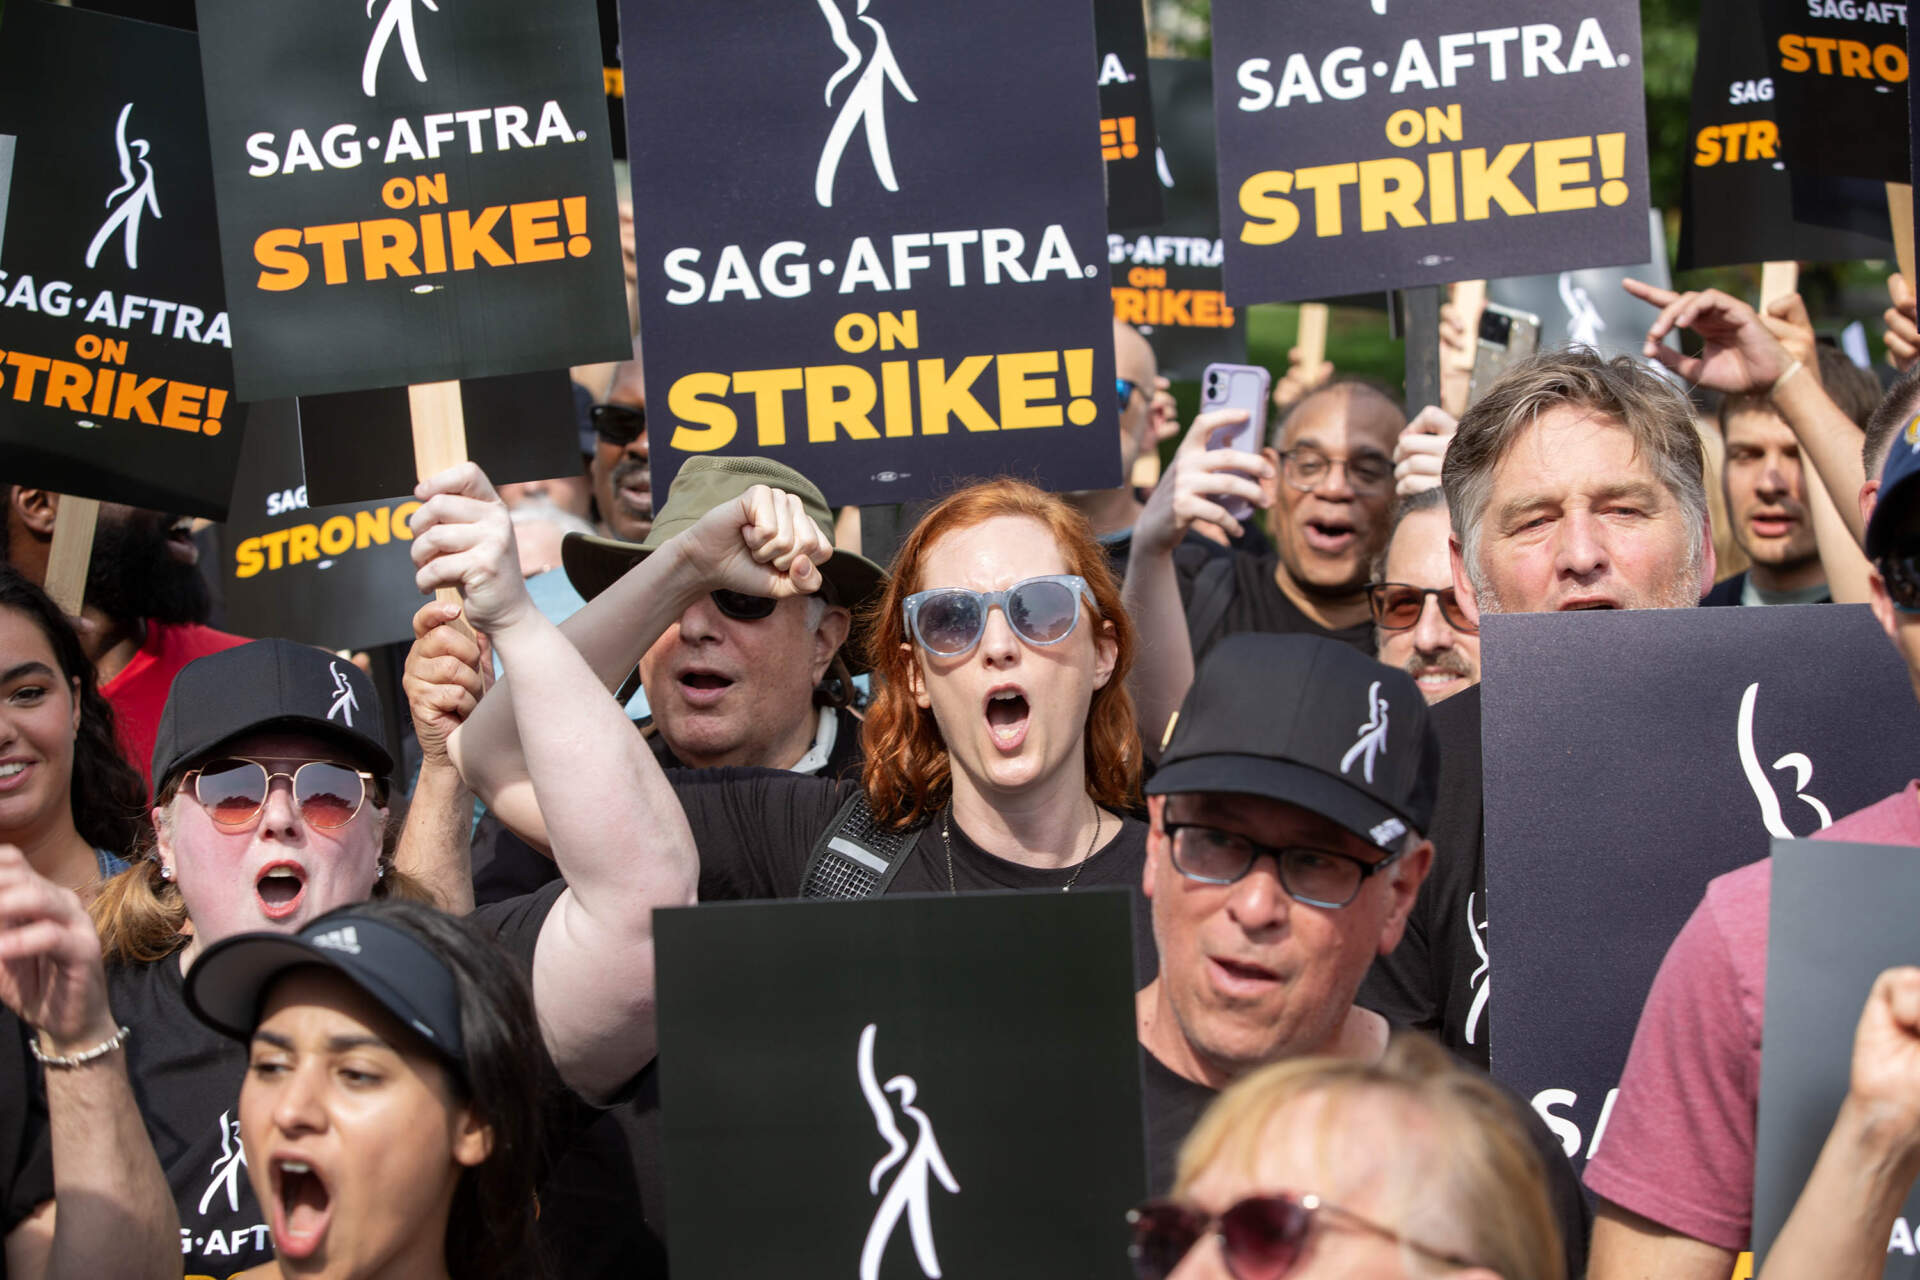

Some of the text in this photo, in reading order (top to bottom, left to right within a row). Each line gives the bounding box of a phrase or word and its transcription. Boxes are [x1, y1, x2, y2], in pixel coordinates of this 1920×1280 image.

[1778, 34, 1910, 83] STRO
[1729, 77, 1774, 105] SAG
[1386, 104, 1464, 149] ON
[1694, 119, 1781, 167] STR
[381, 172, 449, 210] ON
[1239, 132, 1629, 245] STRIKE!
[253, 195, 592, 292] STRIKE!
[1127, 266, 1167, 289] ON
[1110, 286, 1236, 328] RIKE!
[75, 333, 129, 366] ON
[834, 309, 919, 353] ON
[0, 349, 229, 437] TRIKE!
[667, 348, 1098, 453] STRIKE!
